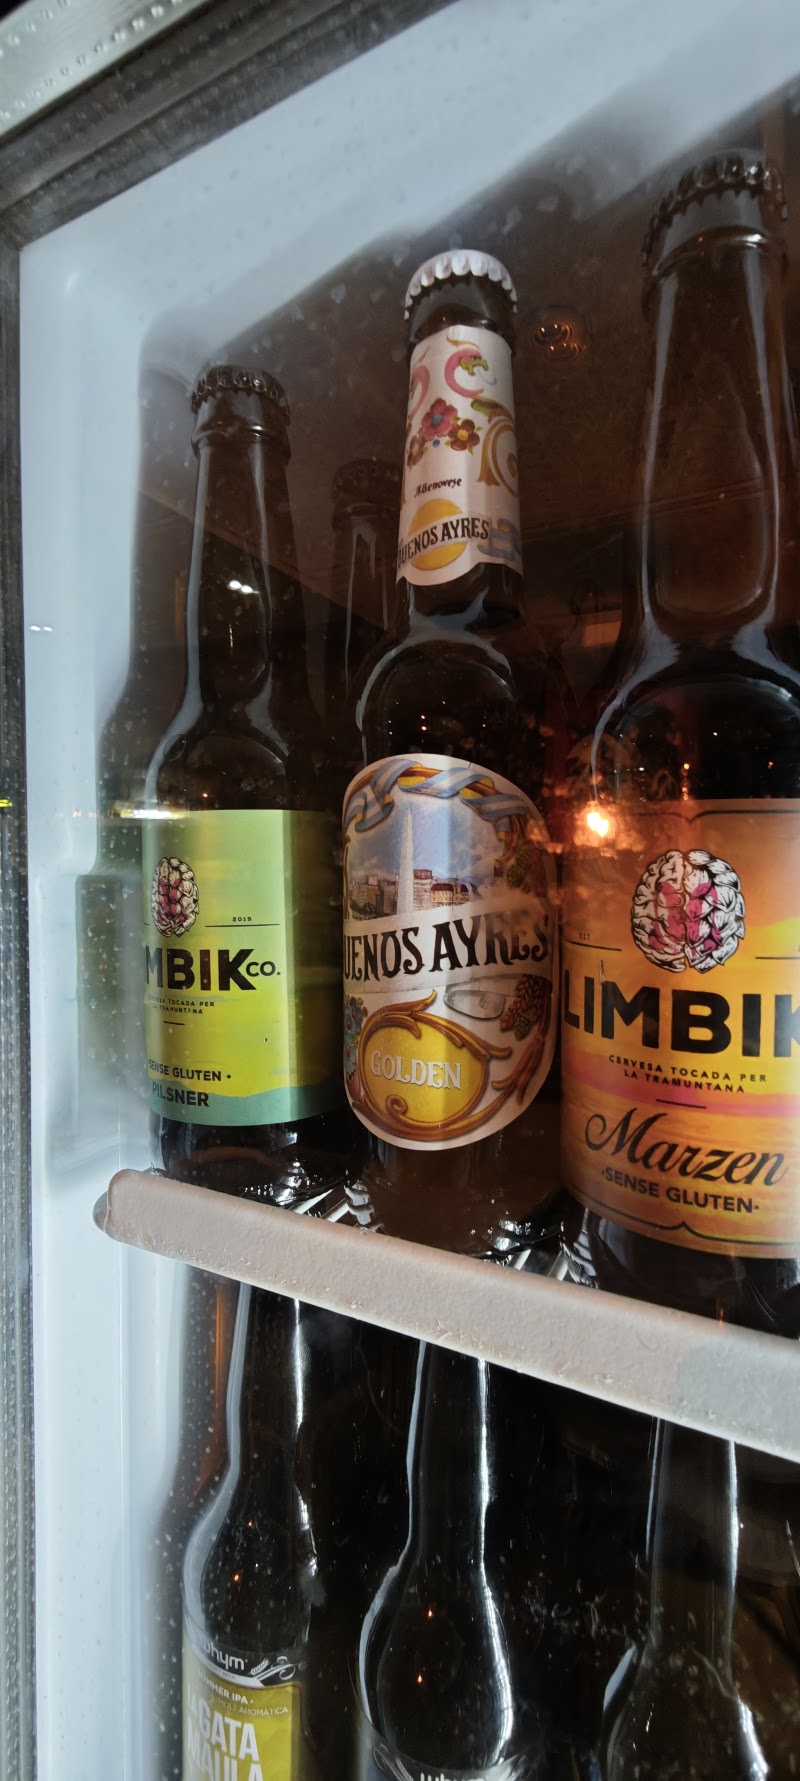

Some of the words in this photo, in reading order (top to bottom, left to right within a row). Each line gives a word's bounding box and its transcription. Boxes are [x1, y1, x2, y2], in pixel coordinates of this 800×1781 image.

[440, 517, 490, 542] AYRES
[343, 926, 425, 982] UENOS
[429, 911, 549, 973] AYRES
[145, 944, 257, 991] MBIK
[168, 998, 195, 1007] TOCADA
[172, 1066, 222, 1081] GLUTEN
[370, 1050, 462, 1089] GOLDEN
[608, 1054, 664, 1073] CERVESA
[670, 1066, 731, 1081] TOCADA
[740, 1073, 767, 1083] PER
[624, 1068, 638, 1079] LA
[645, 1073, 745, 1093] TRAMUNTANA
[152, 1081, 210, 1108] PILSNER
[584, 1107, 790, 1186] Marzen
[231, 1692, 248, 1705] IPA
[199, 1697, 260, 1762] GATA
